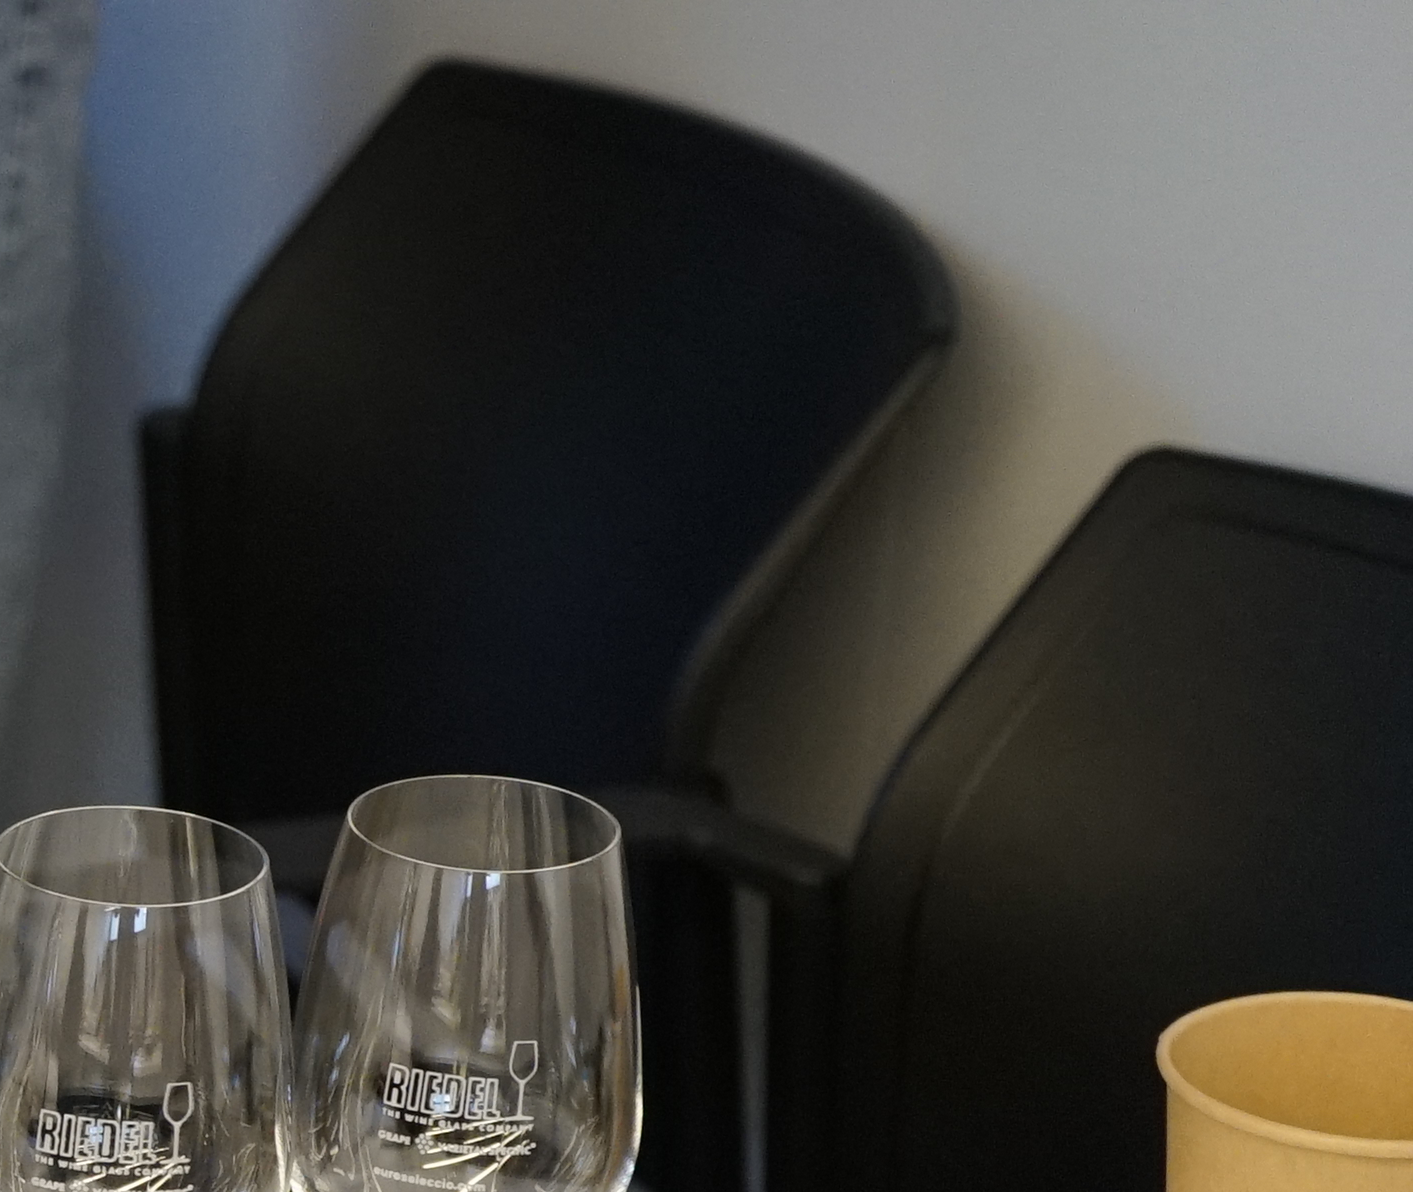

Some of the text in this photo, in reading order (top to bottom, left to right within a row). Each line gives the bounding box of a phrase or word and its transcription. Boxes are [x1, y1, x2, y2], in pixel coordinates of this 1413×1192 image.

[383, 1062, 501, 1121] RIEDEL
[382, 1108, 401, 1119] THE
[404, 1113, 434, 1126] WINE
[35, 1108, 157, 1165] RIEDEL
[35, 1154, 55, 1166] THE
